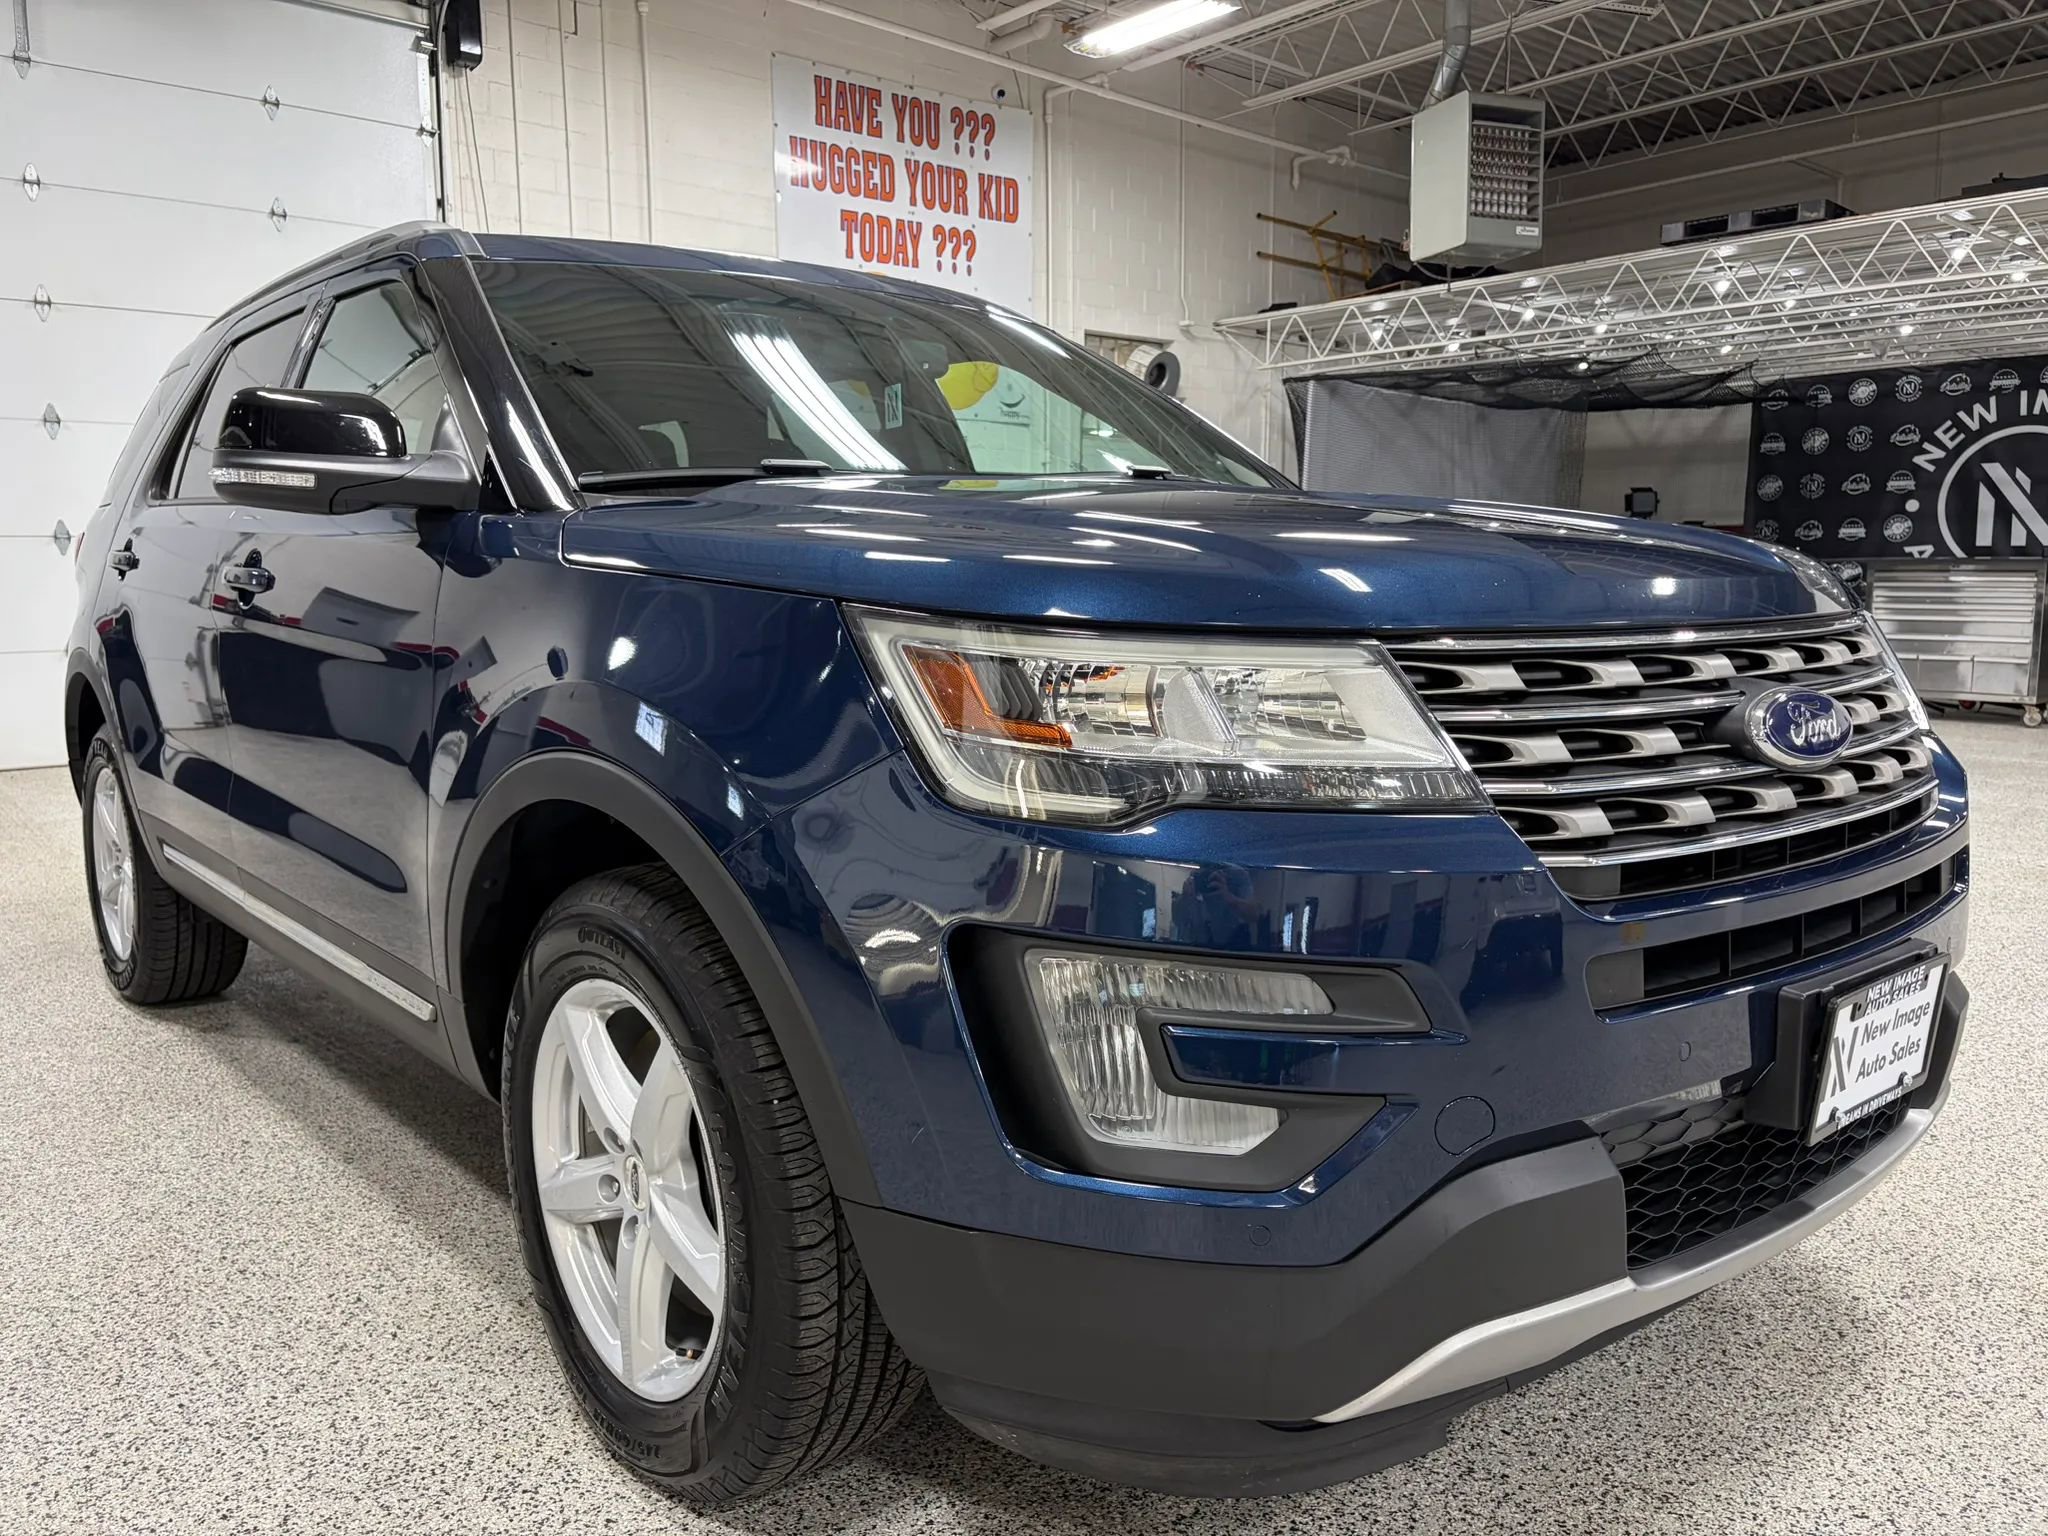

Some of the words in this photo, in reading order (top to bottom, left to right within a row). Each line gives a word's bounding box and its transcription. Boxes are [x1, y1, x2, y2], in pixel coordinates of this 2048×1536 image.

[814, 75, 883, 138] HAVE
[892, 92, 941, 150] YOU
[950, 106, 996, 161] ???
[789, 135, 896, 202] HUGGED
[904, 158, 969, 216] YOUR
[978, 173, 1019, 224] KID
[840, 209, 922, 268] TODAY
[933, 224, 977, 277] ???
[1912, 395, 1998, 473] NEW
[1787, 701, 1841, 746] Ford
[1865, 995, 1891, 1015] AUTO
[1892, 981, 1922, 1003] SALES
[1867, 979, 1893, 1003] NEW
[1893, 965, 1926, 991] IMAGE
[1861, 1020, 1891, 1046] New
[1892, 1001, 1930, 1031] Image
[1855, 1055, 1887, 1083] Auto
[1889, 1035, 1922, 1065] Sales
